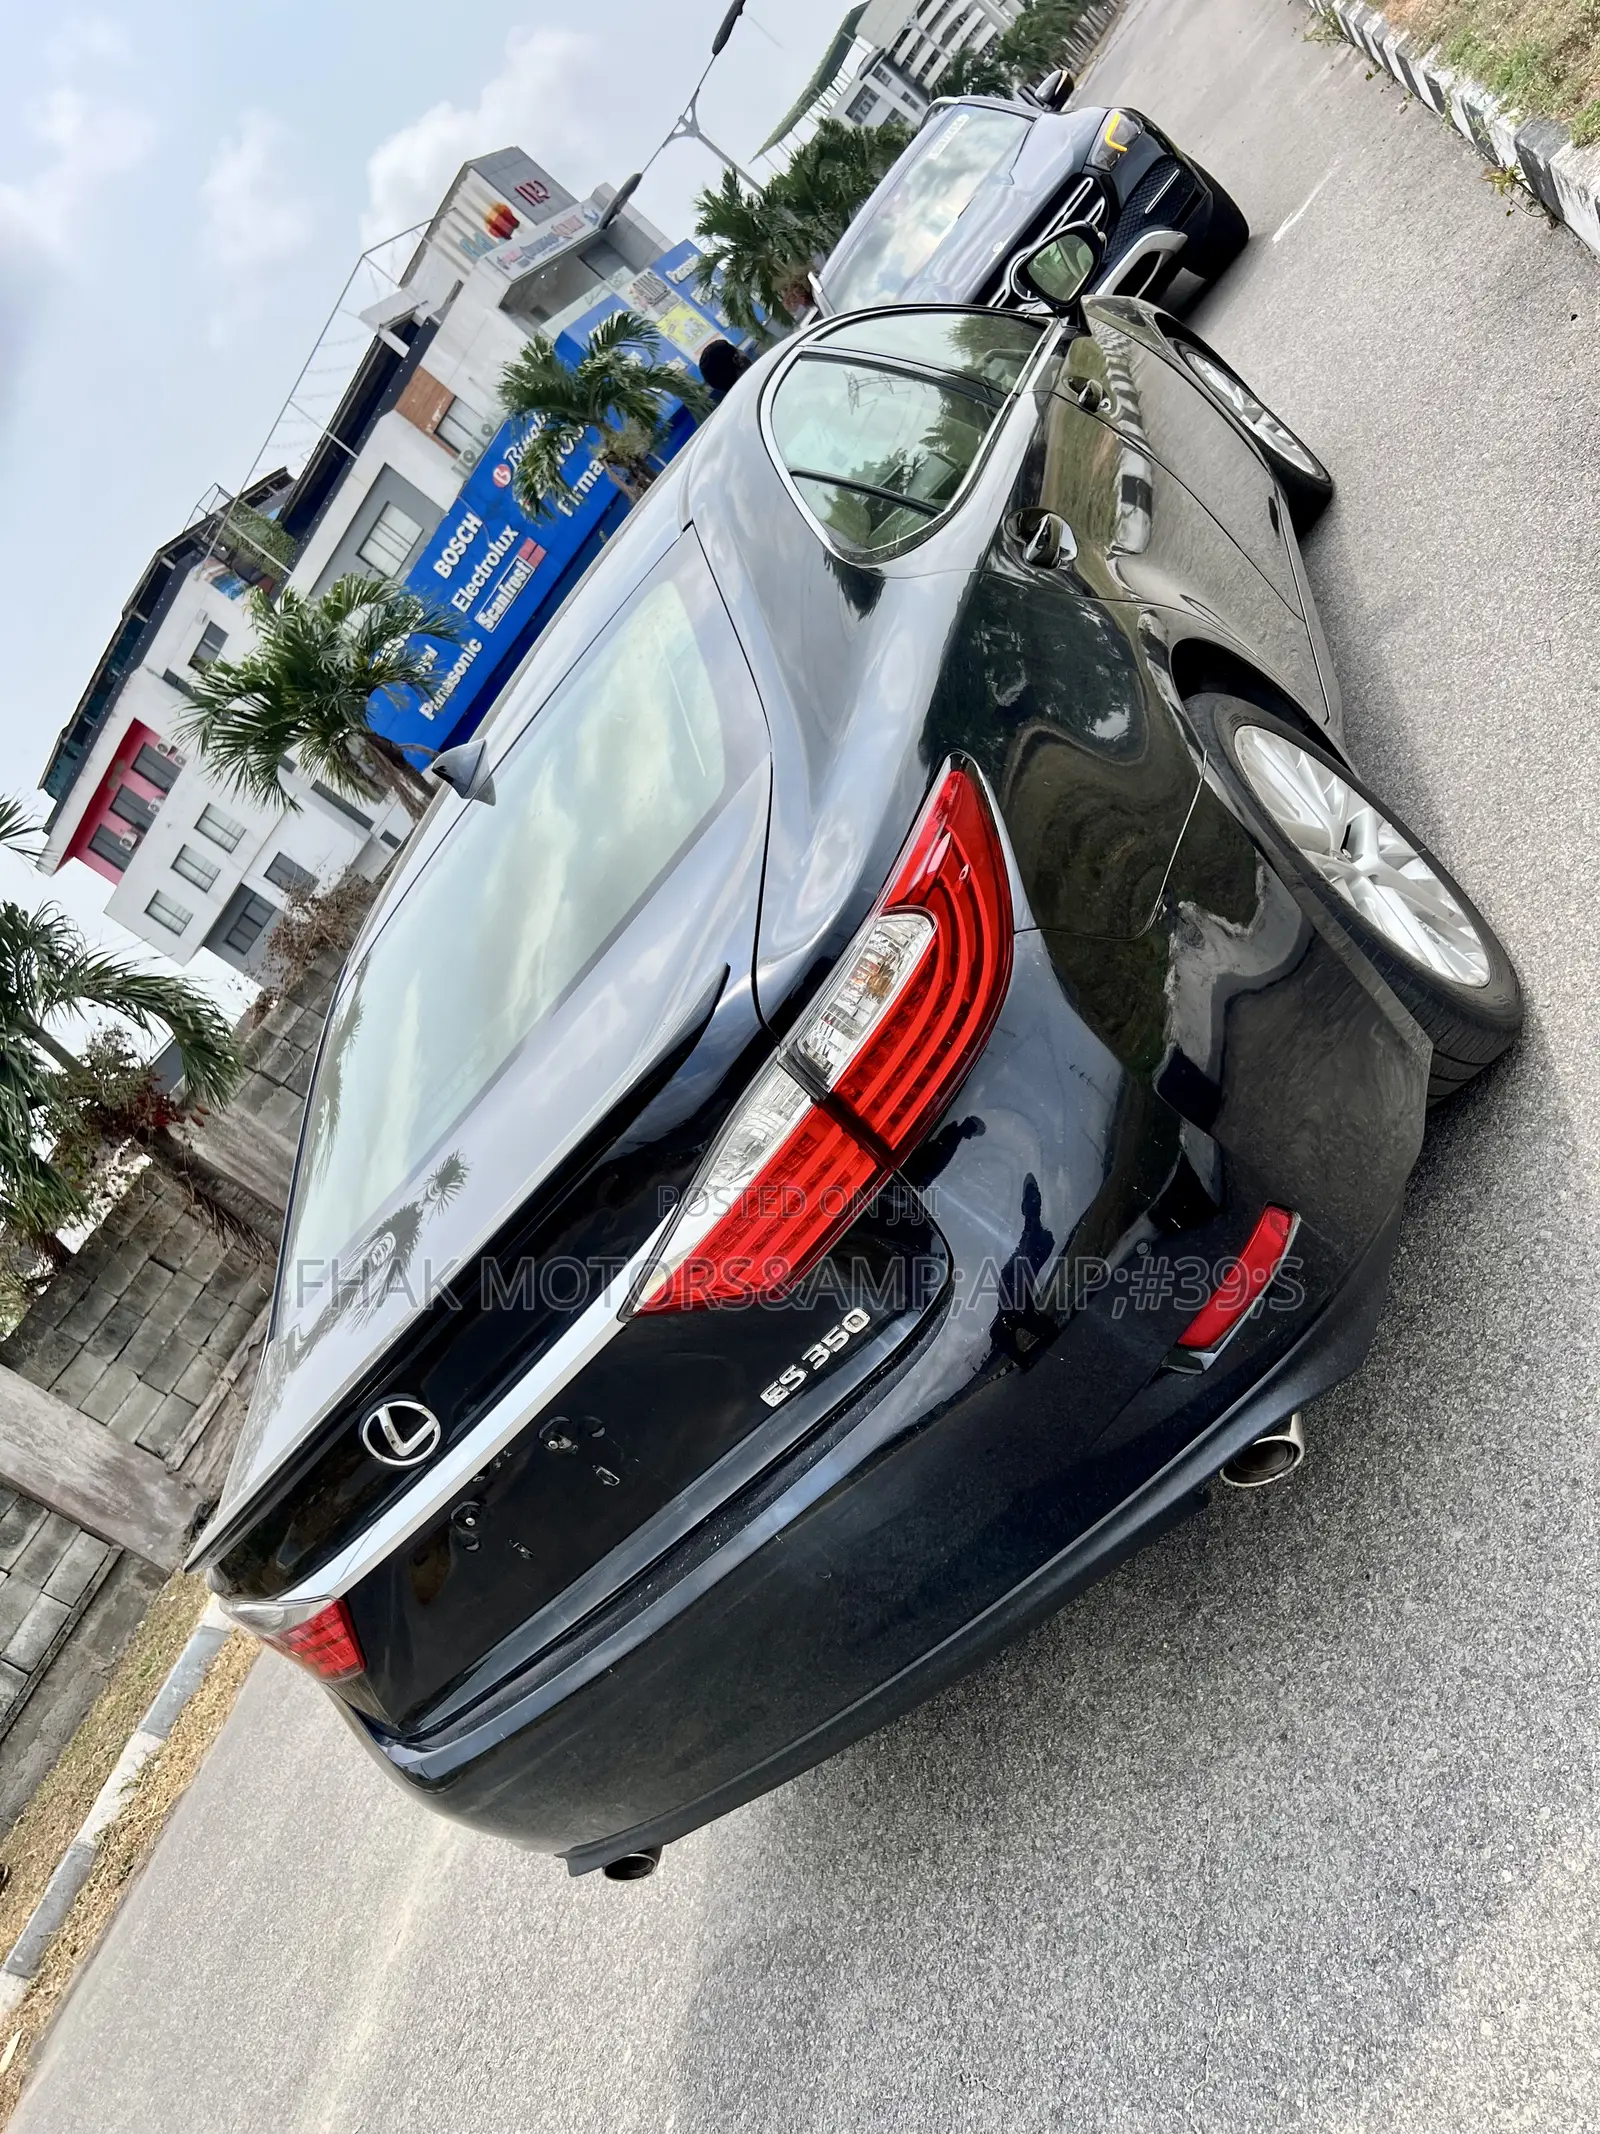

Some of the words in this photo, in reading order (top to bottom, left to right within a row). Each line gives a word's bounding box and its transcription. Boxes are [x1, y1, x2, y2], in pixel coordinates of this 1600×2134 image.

[433, 511, 483, 579] BOSCH
[450, 524, 519, 613] Electrolux
[478, 560, 532, 630] Scanfrost
[760, 1363, 809, 1408] ES
[801, 1307, 871, 1370] 350
